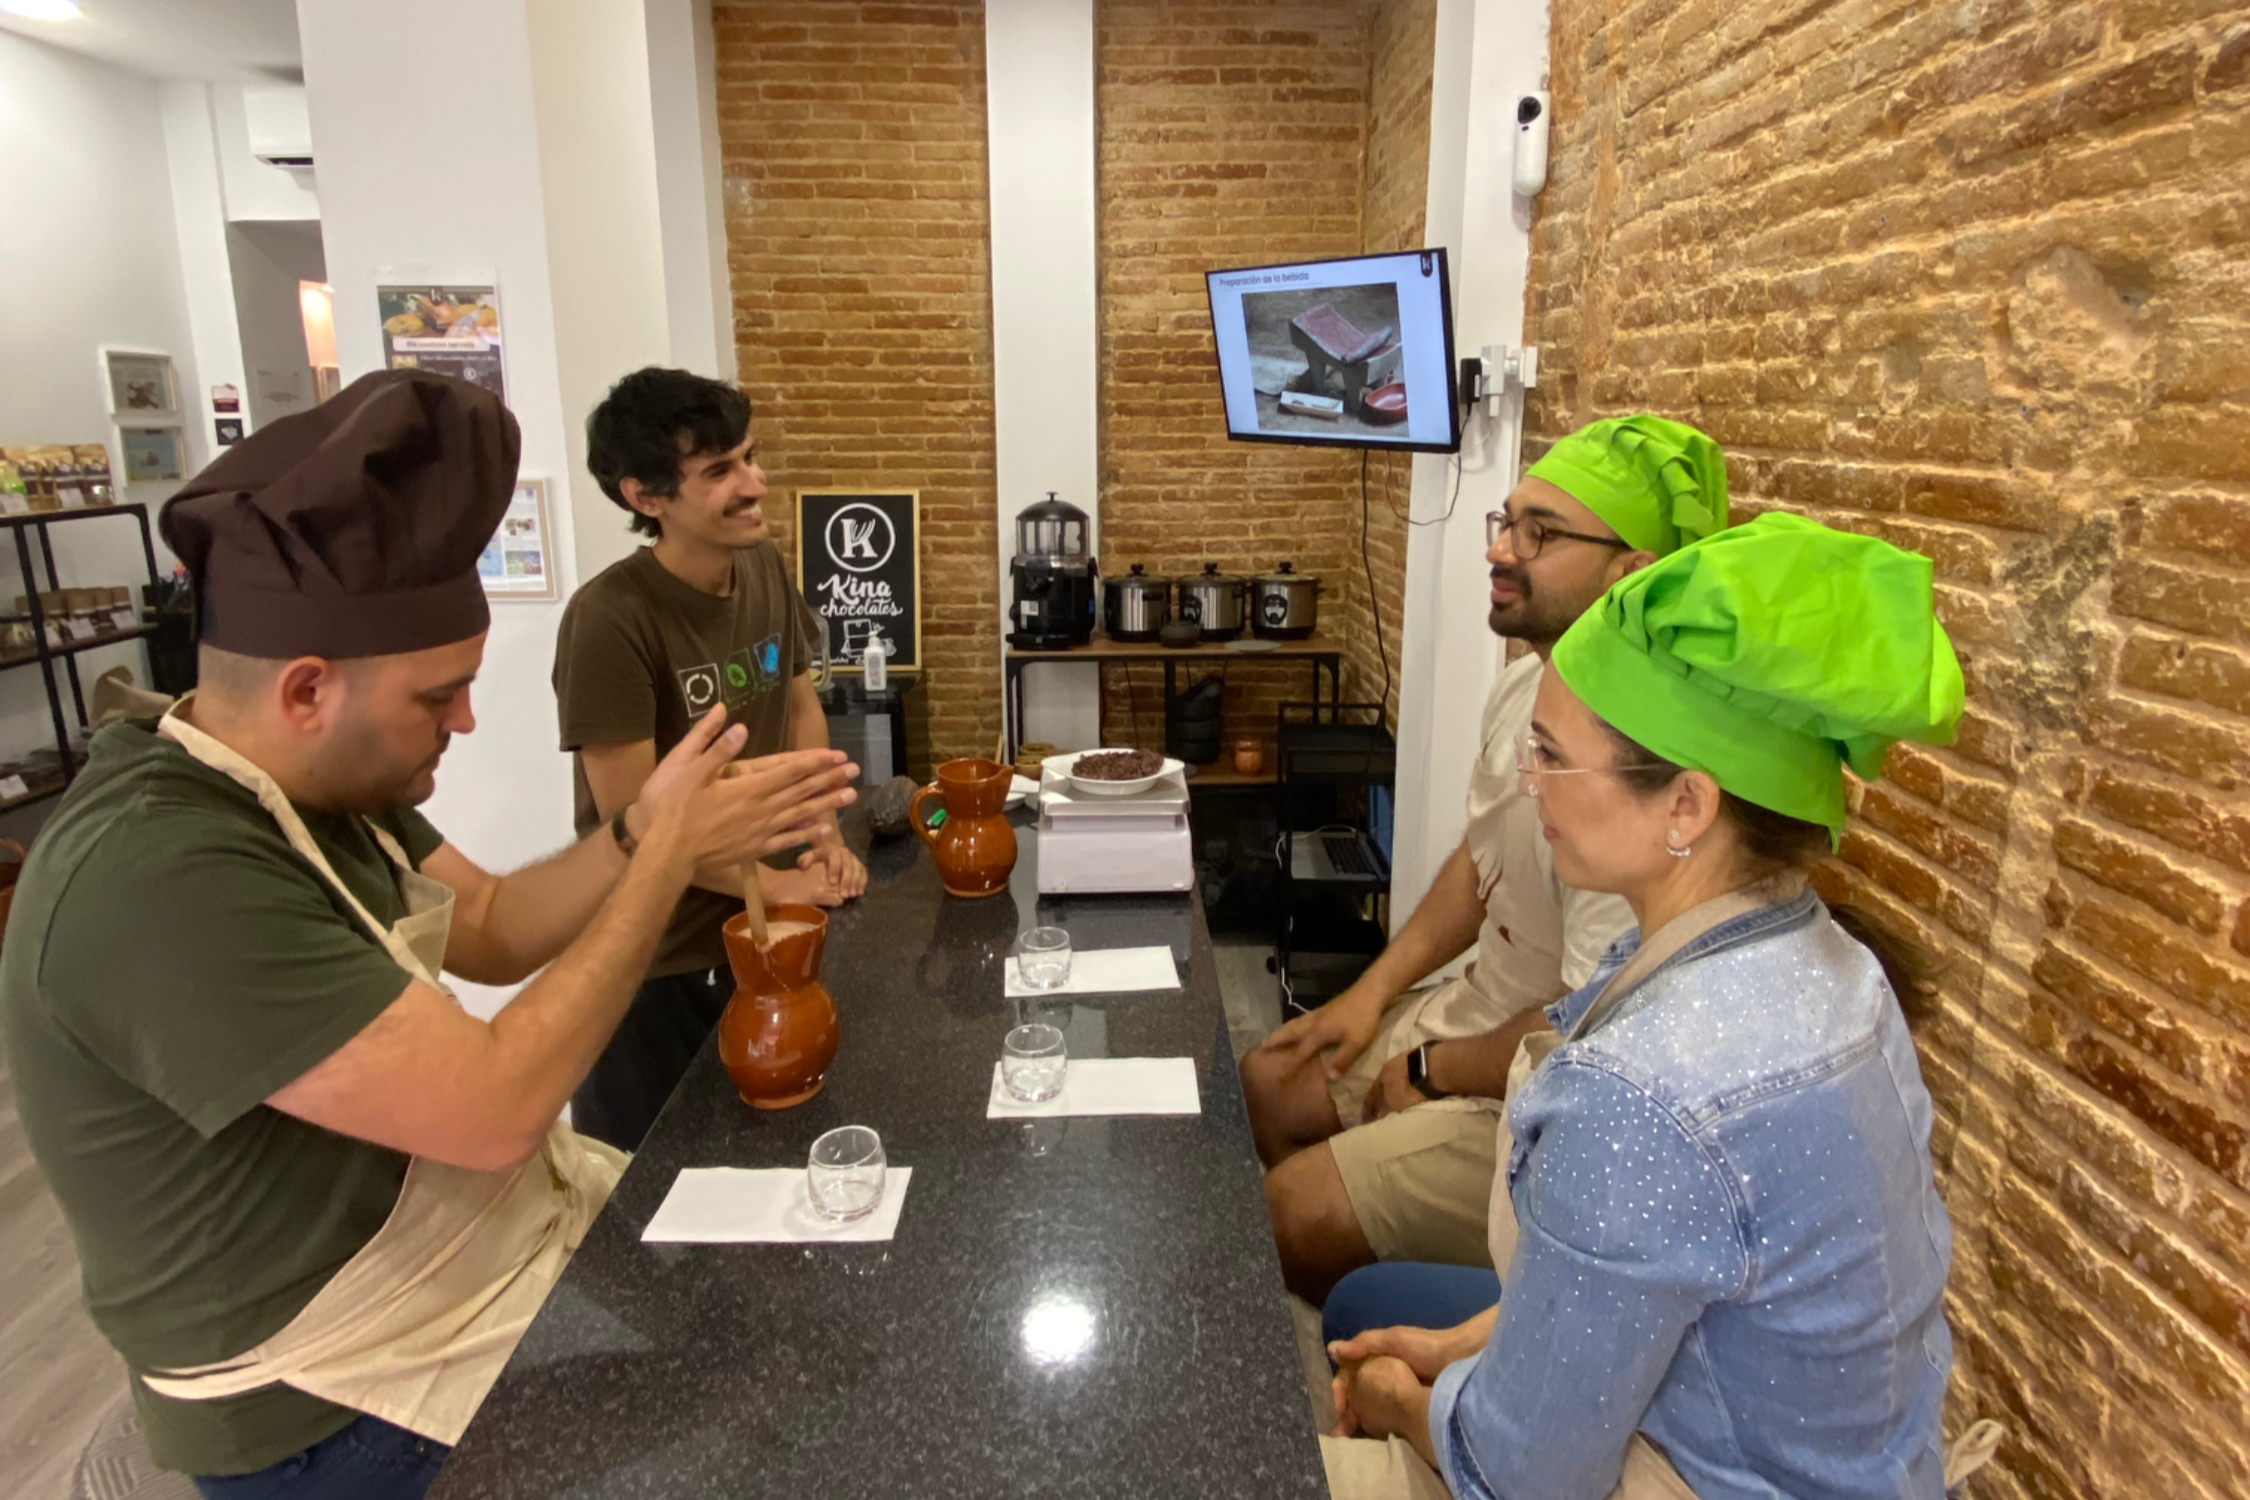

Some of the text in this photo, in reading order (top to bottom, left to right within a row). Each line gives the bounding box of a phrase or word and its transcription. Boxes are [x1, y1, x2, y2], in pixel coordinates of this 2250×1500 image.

[1219, 271, 1309, 288] Preparación de la bebida
[817, 573, 892, 605] Kina
[820, 597, 903, 617] chocolates
